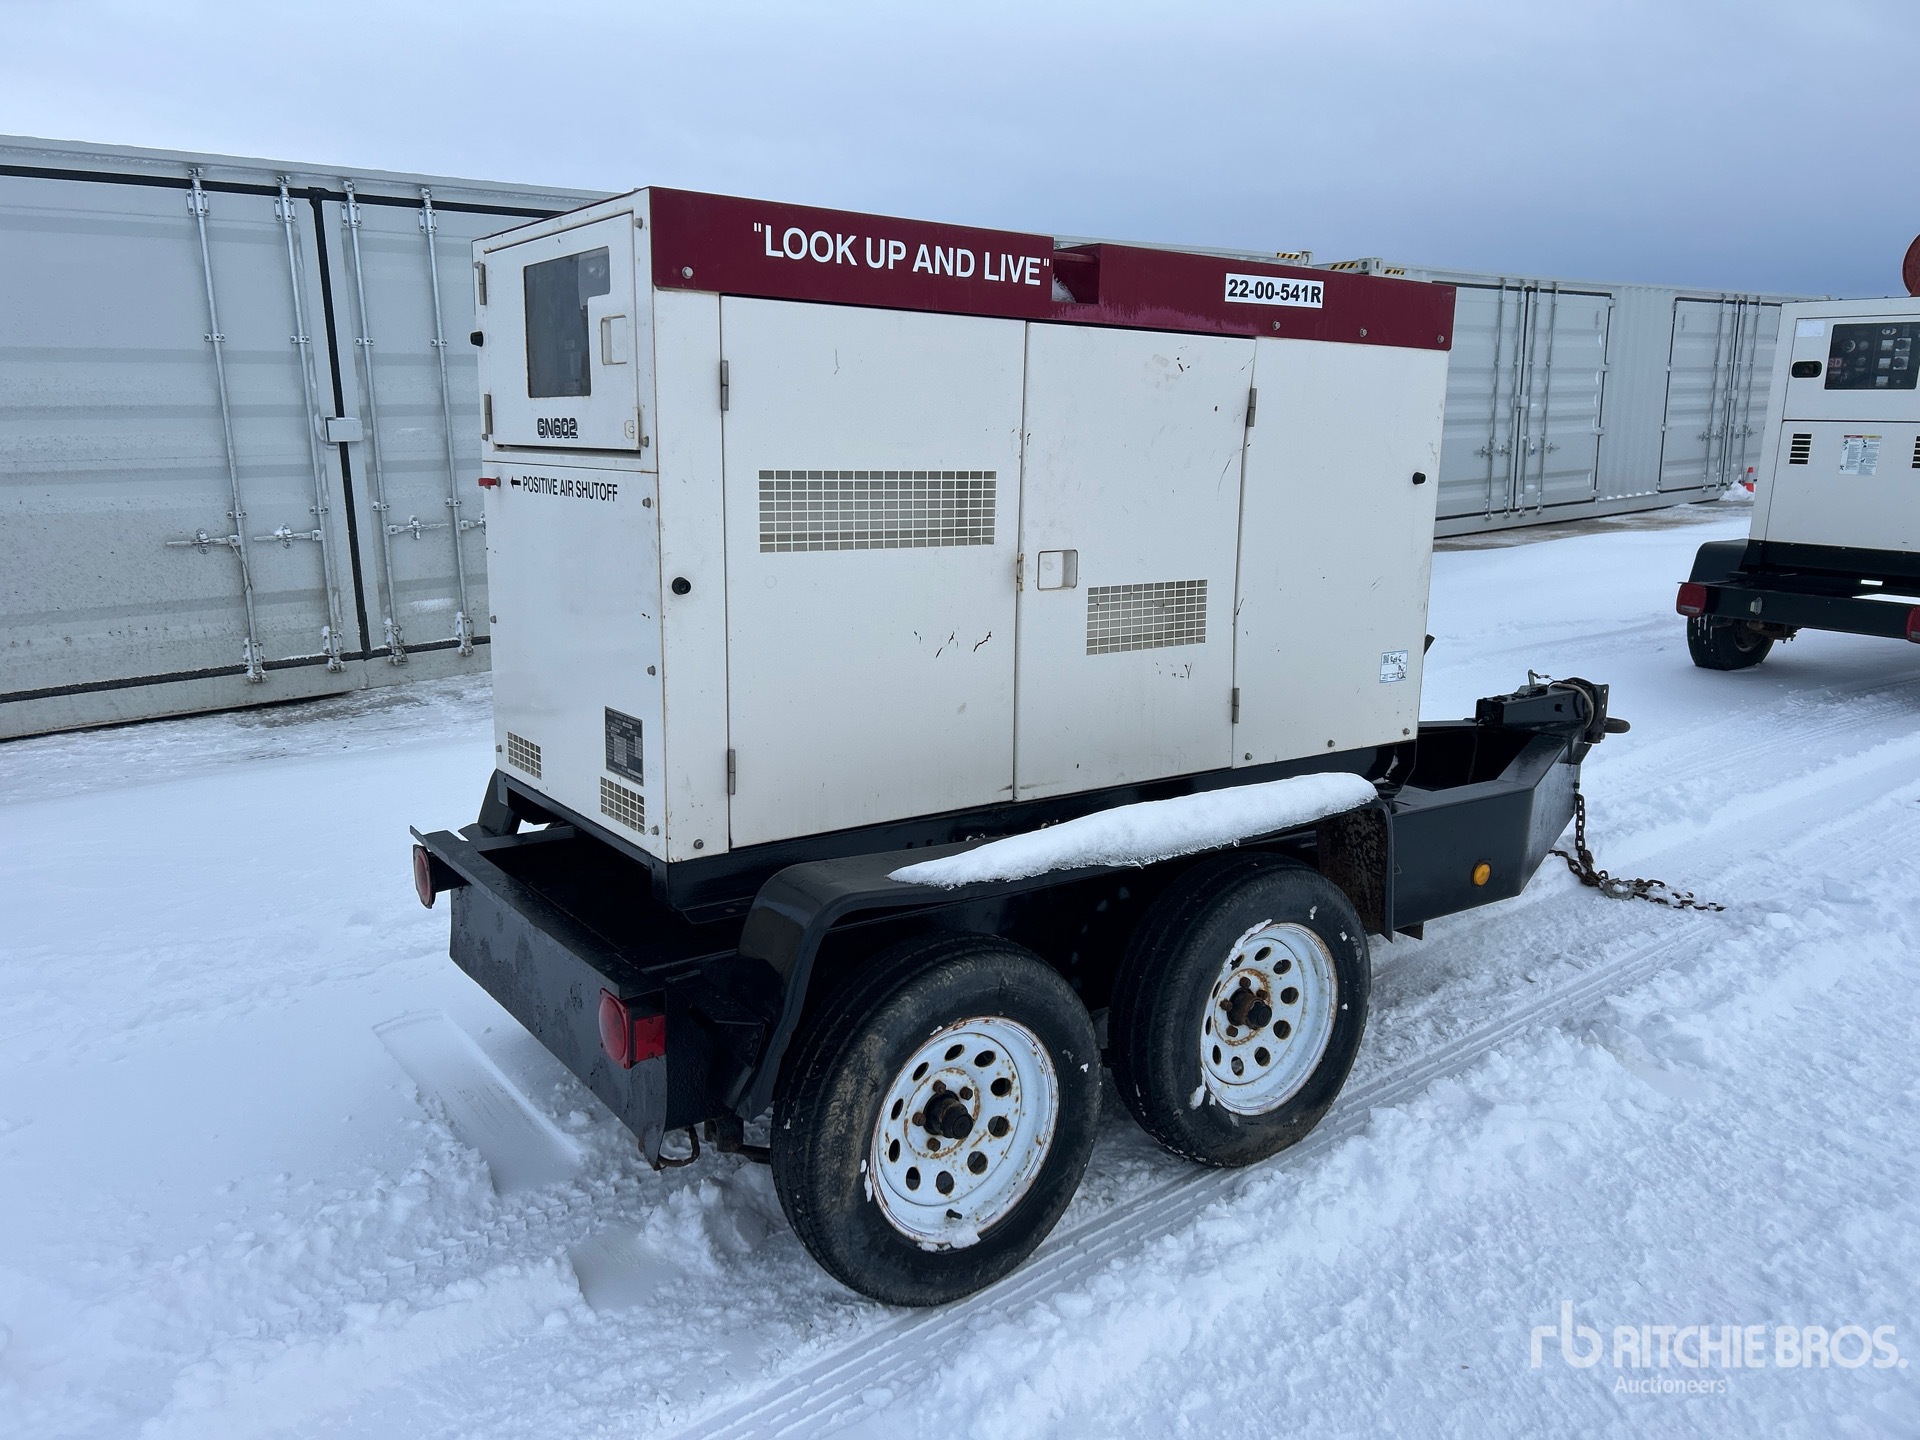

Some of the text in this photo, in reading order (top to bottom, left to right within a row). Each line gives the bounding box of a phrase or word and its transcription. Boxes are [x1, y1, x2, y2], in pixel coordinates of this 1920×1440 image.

[753, 222, 1050, 286] "LOOK UP AND LIVE"
[1227, 279, 1322, 304] 22-00-541R
[537, 417, 578, 438] GN602
[522, 475, 618, 502] POSITIVE AIR SHUTOFF
